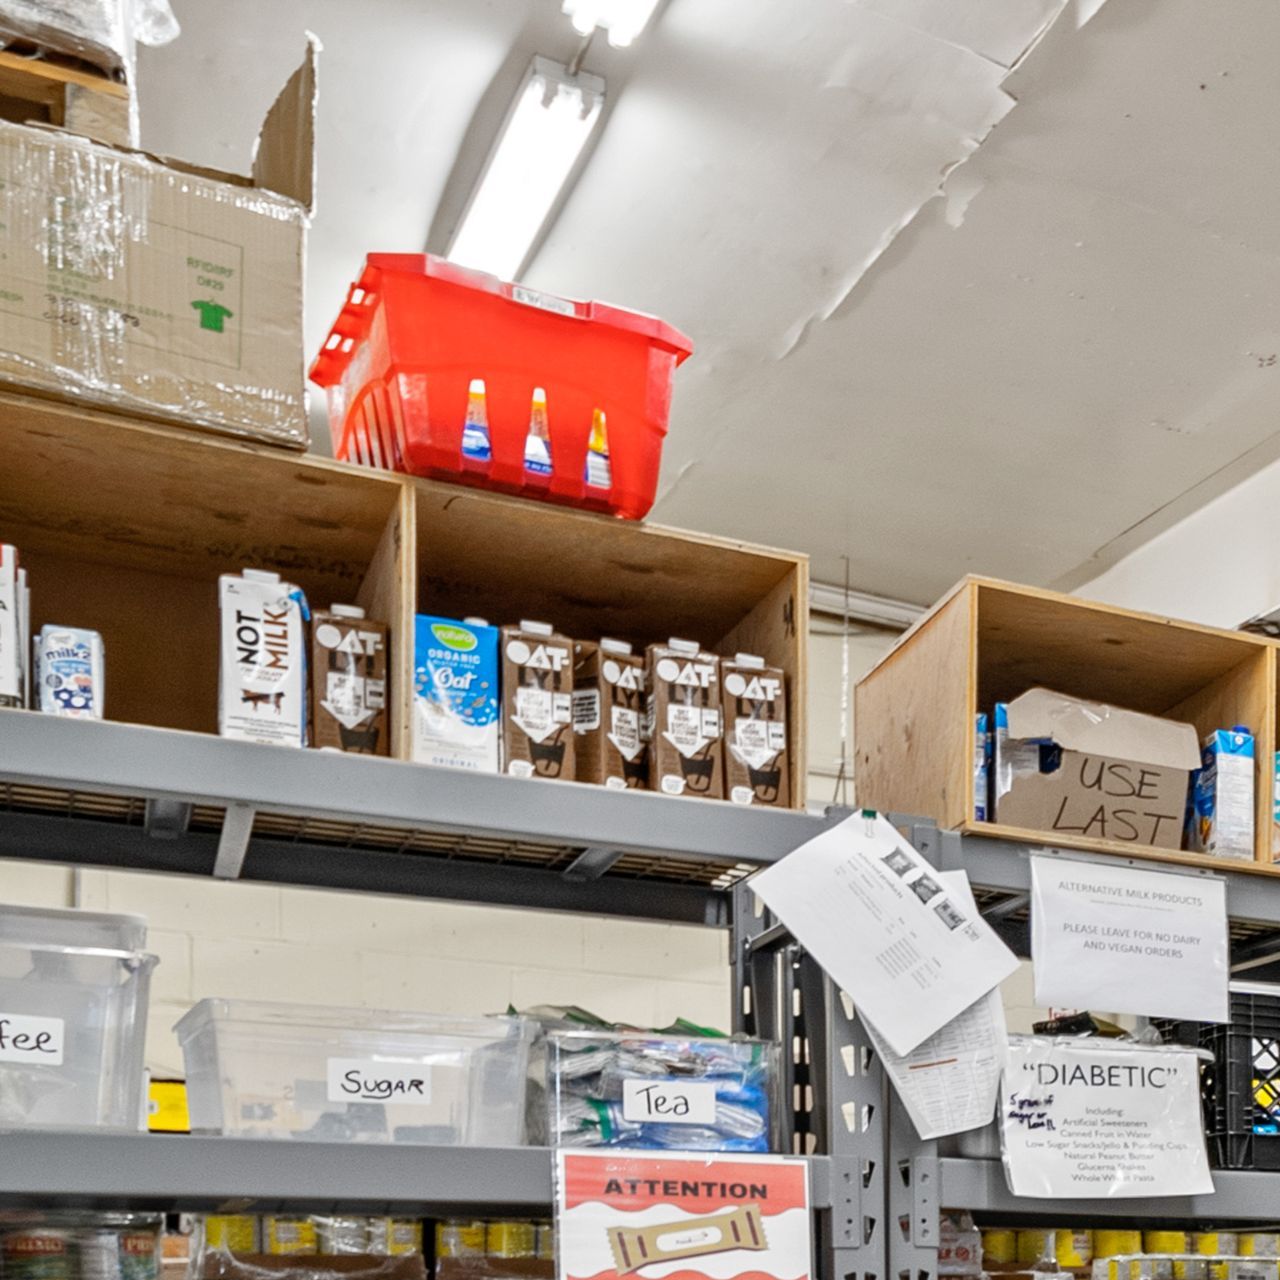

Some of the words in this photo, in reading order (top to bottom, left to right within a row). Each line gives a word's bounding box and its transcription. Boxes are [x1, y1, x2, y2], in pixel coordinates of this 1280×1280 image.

[236, 610, 260, 666] NOT
[264, 608, 288, 670] MILK
[428, 649, 480, 664] ORGANIC
[435, 667, 477, 690] Oat
[1080, 758, 1161, 799] USE
[1052, 796, 1177, 845] LAST
[1058, 881, 1123, 897] ALTERNATIVE
[1126, 889, 1150, 900] MILK
[1152, 892, 1203, 906] PRODUCTS
[1063, 923, 1099, 936] PLEASE
[1101, 928, 1130, 939] LEAVE
[1134, 930, 1153, 941] FOR
[1155, 933, 1171, 942] NO
[1173, 934, 1201, 945] DAIRY
[1083, 941, 1105, 951] AND
[1108, 943, 1143, 955] VEGAN
[1145, 947, 1183, 959] ORDERS
[636, 1086, 691, 1116] Tea
[604, 1179, 767, 1199] ATTENTION
